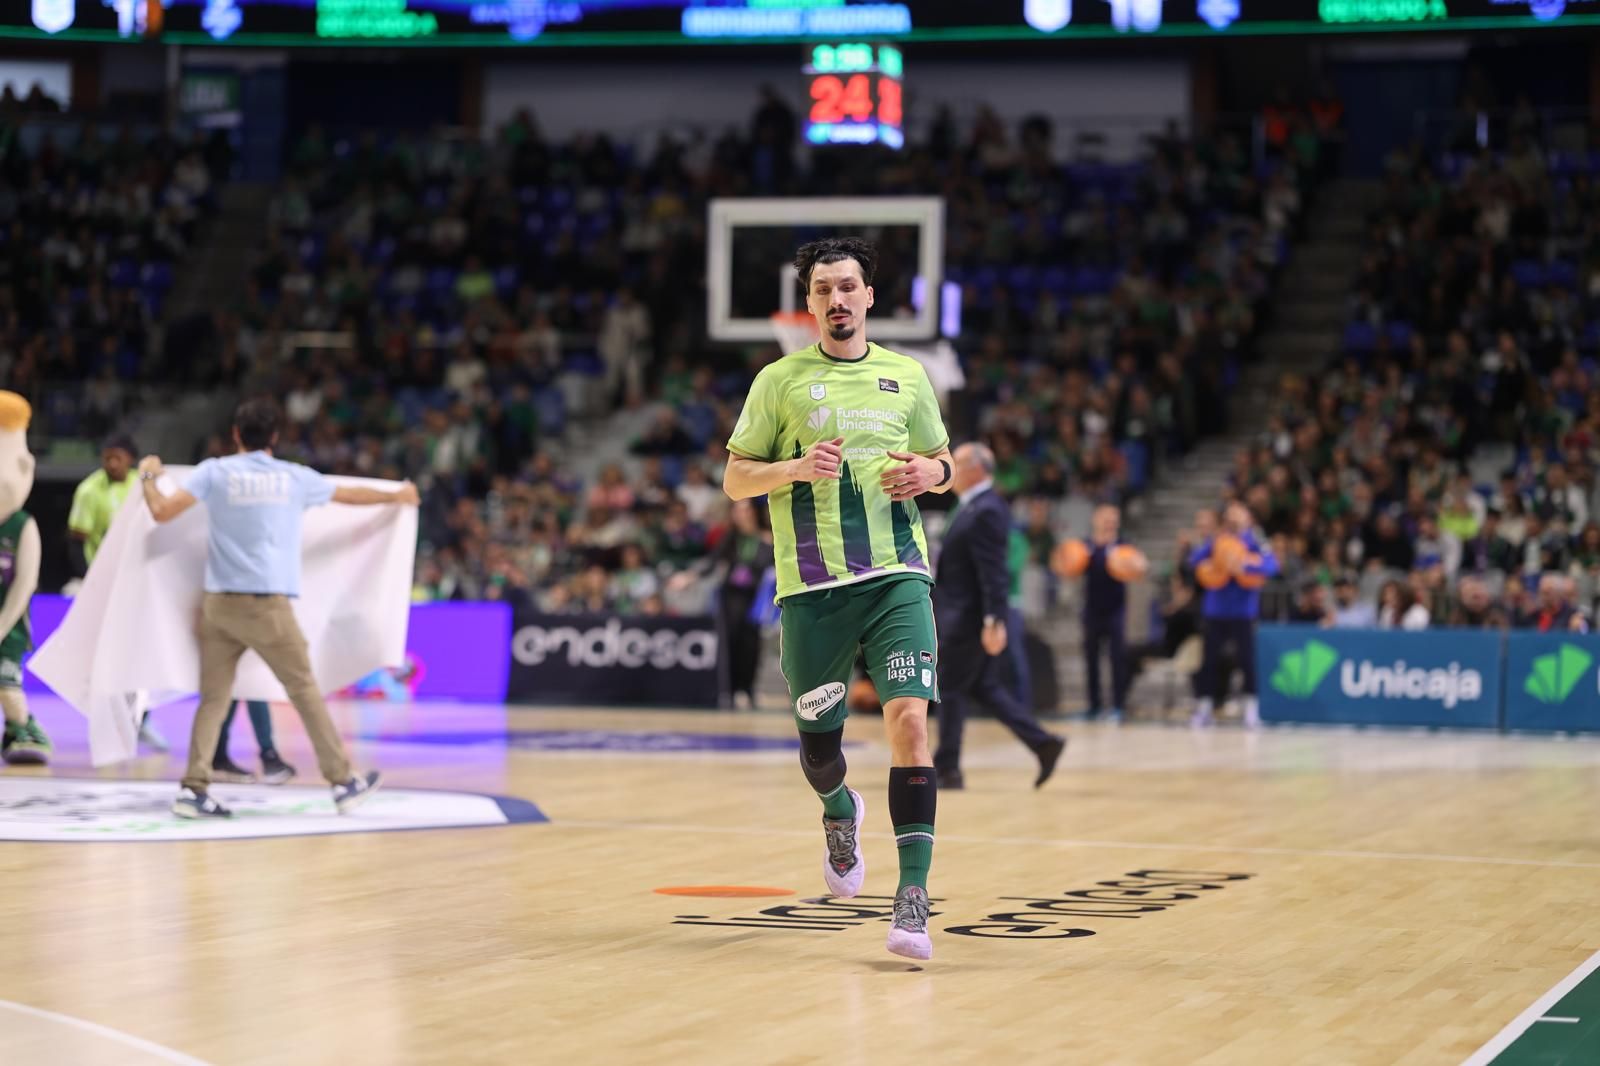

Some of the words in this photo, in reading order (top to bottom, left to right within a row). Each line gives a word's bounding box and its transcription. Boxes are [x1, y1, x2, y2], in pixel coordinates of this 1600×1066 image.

[809, 74, 873, 122] 24
[836, 407, 902, 423] Fundación
[836, 419, 884, 433] Unicaja
[511, 617, 718, 670] endesa
[890, 651, 916, 669] má
[887, 667, 916, 682] laga
[1340, 659, 1483, 708] Unicaja
[943, 869, 1258, 939] endesa
